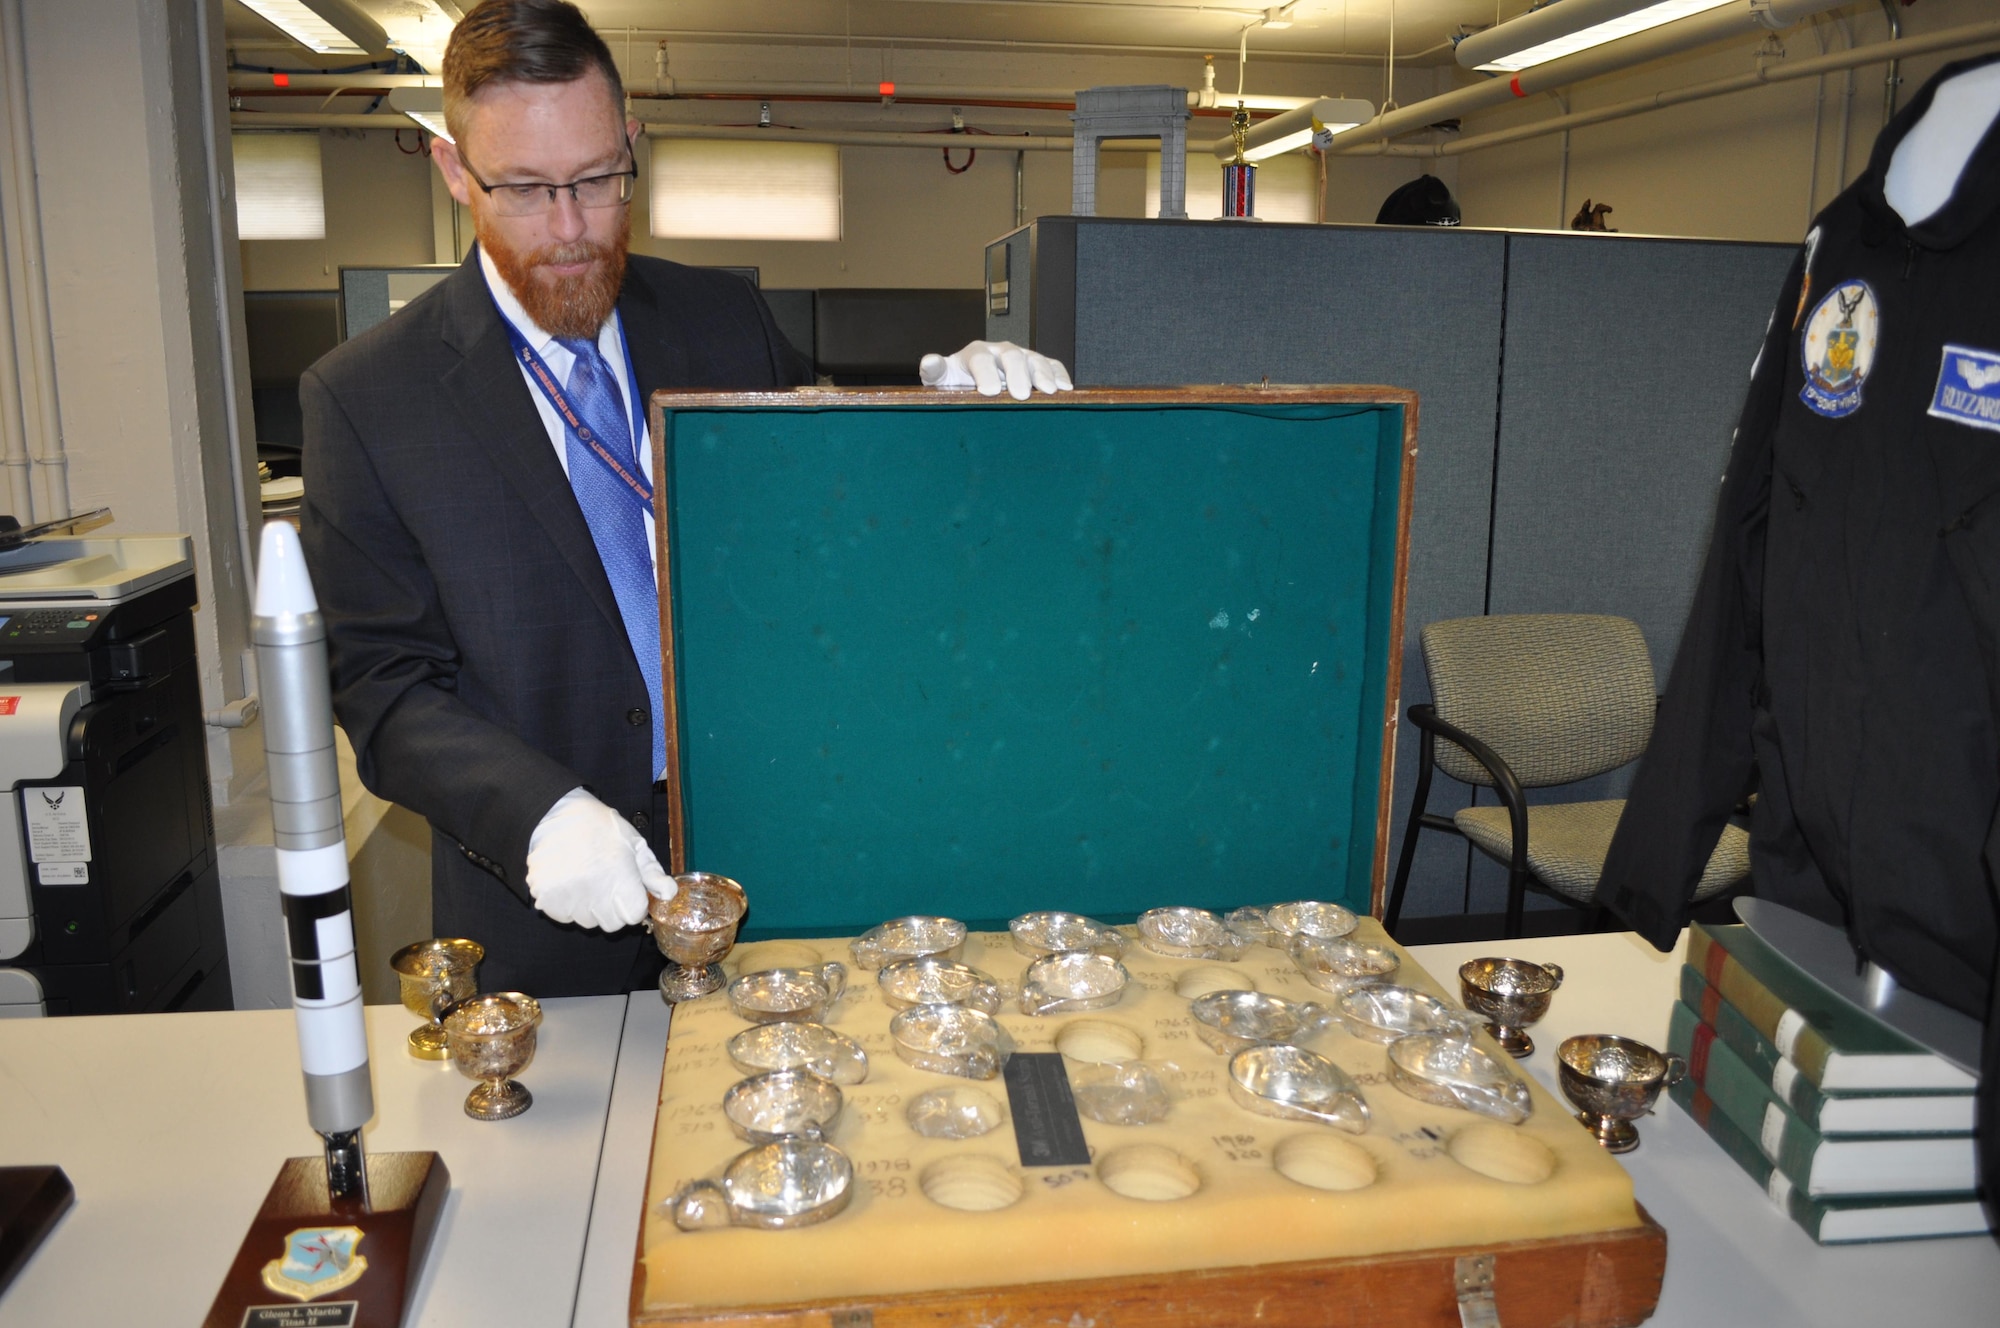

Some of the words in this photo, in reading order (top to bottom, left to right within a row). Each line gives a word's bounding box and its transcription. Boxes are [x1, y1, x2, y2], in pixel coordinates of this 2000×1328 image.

[855, 1158, 911, 1174] 1978
[259, 1309, 290, 1320] Glenn
[292, 1308, 303, 1318] L.
[306, 1305, 342, 1316] Martin
[280, 1318, 306, 1328] Titan
